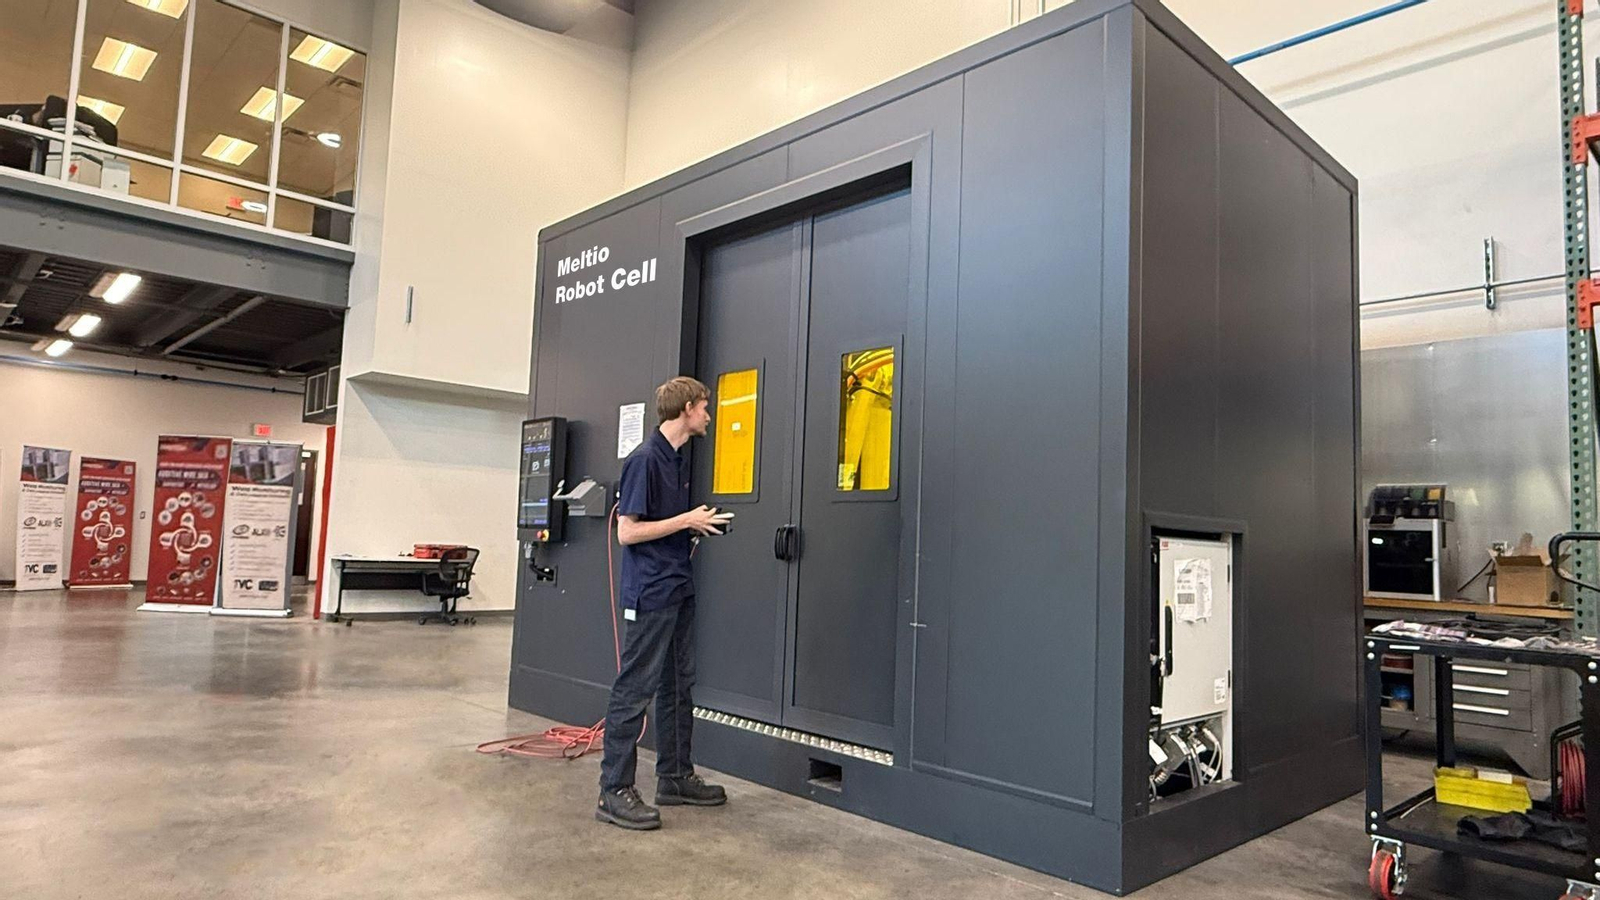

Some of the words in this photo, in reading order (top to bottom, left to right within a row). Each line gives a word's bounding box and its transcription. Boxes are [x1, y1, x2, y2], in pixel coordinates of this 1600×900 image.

[555, 274, 605, 304] Robot
[611, 257, 657, 290] Cell
[557, 245, 610, 277] Meltio
